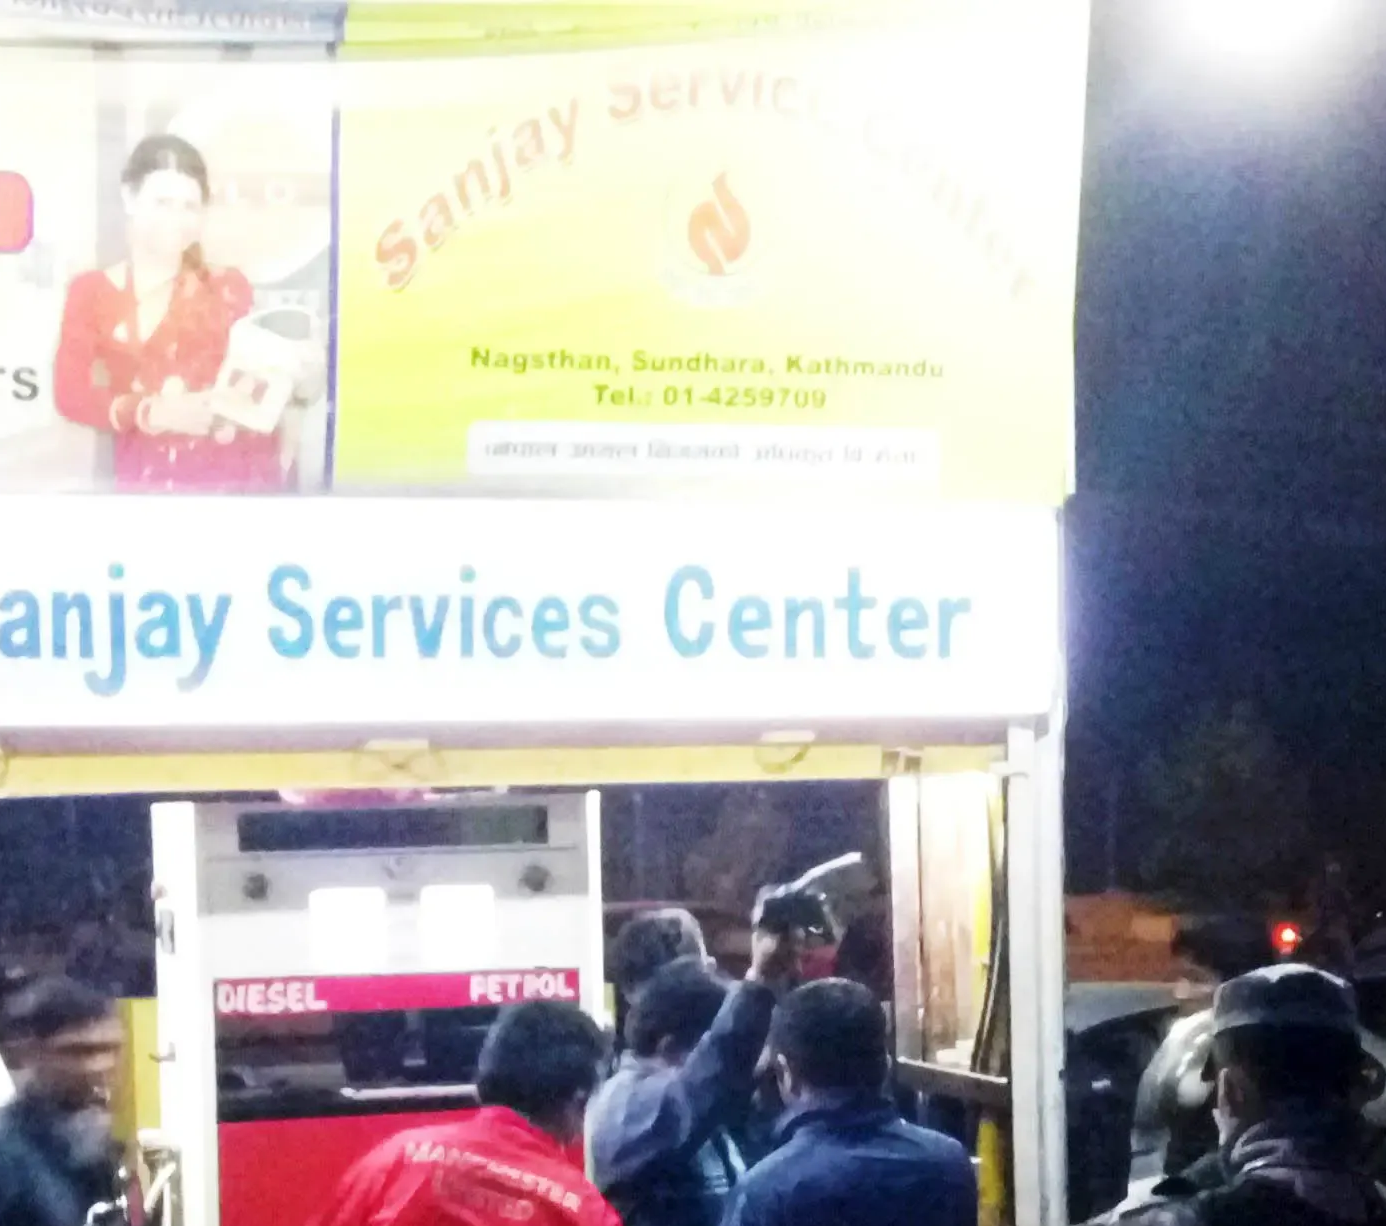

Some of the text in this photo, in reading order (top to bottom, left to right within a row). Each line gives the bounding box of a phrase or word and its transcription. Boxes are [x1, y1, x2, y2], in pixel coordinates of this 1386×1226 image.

[375, 97, 581, 293] Sanjay
[470, 346, 945, 379] Nagsthan, Sundhara, Kathmandu
[266, 562, 623, 661] Services
[663, 563, 972, 661] Center
[216, 980, 328, 1014] DIESEL
